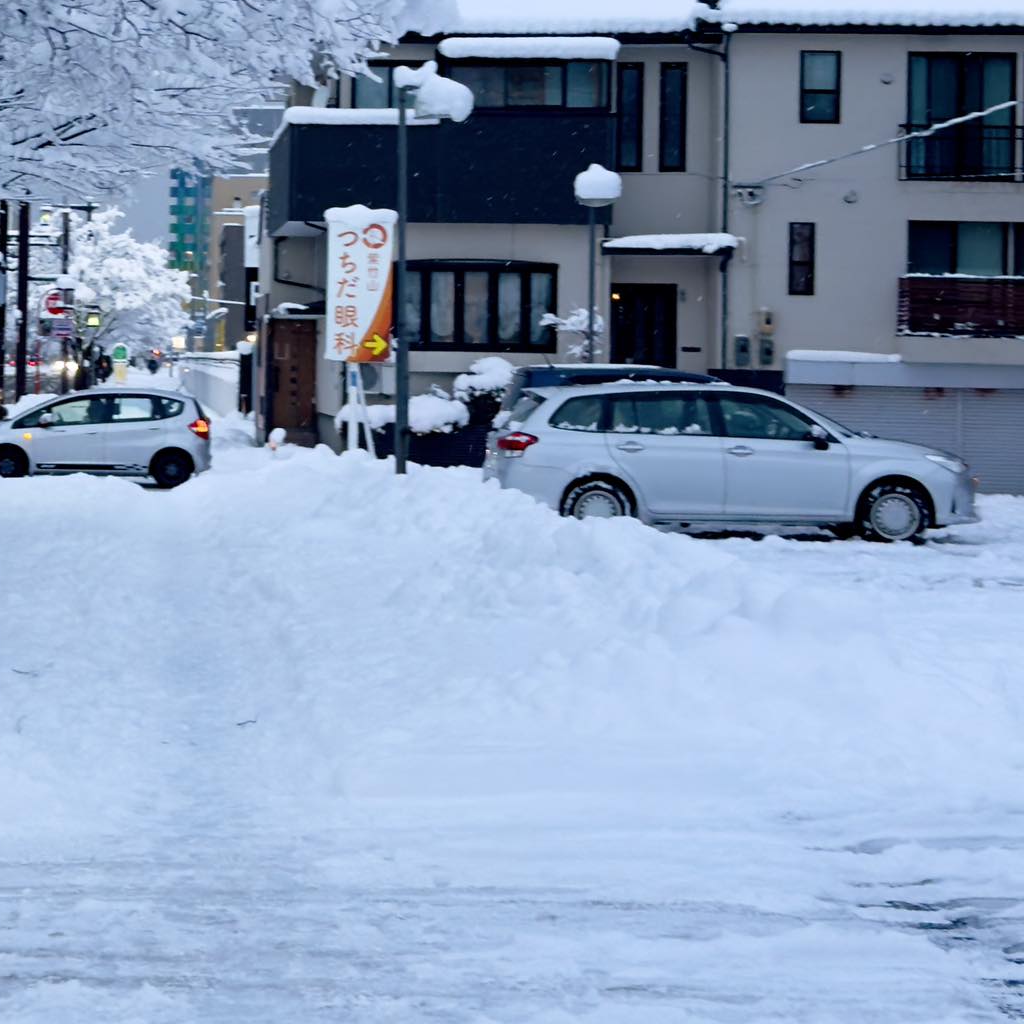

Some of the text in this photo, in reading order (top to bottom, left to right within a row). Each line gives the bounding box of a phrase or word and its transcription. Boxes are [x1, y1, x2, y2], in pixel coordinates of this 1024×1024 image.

[333, 231, 360, 354] つちだ眼科
